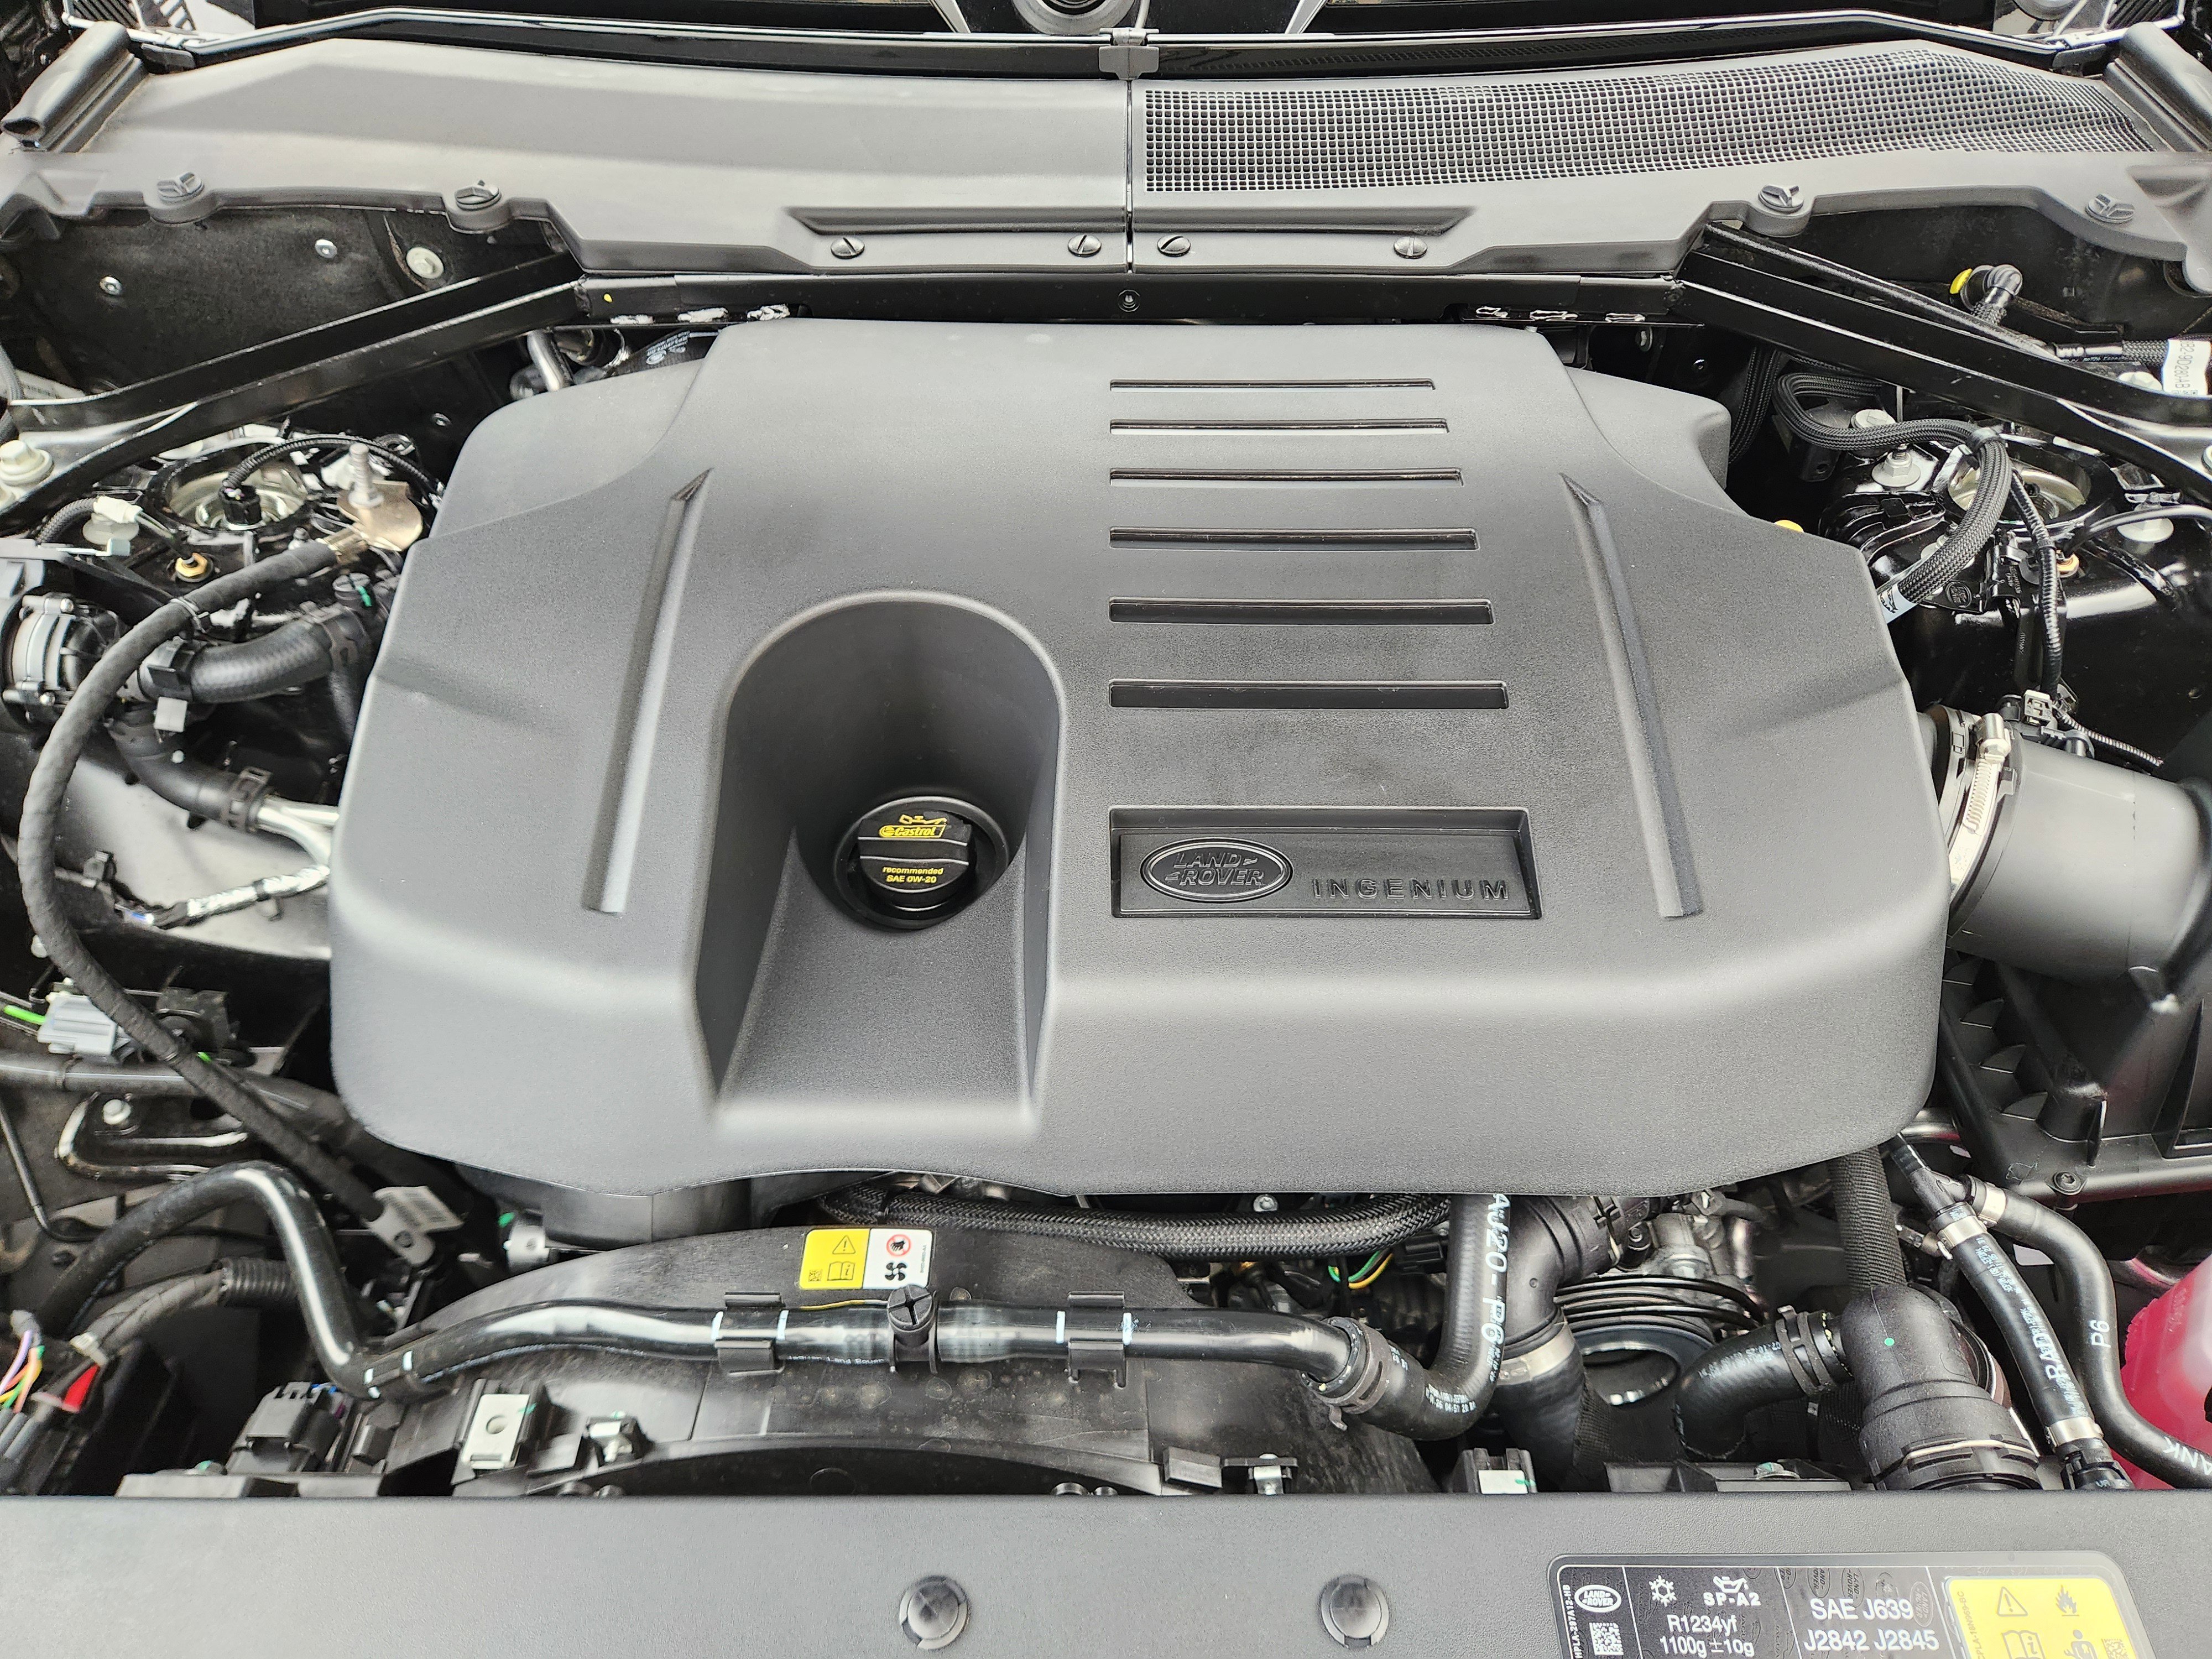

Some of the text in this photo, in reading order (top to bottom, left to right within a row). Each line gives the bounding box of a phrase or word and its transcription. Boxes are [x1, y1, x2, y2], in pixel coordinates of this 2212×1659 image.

[894, 826, 936, 836] Castrol
[1174, 853, 1241, 868] LAND
[886, 874, 905, 883] SAE
[1180, 868, 1264, 885] ROVER
[1312, 878, 1509, 900] INGENIUM
[1481, 1297, 1505, 1345] P6
[2090, 1319, 2111, 1348] P6
[826, 1356, 851, 1364] Land
[1587, 1598, 1614, 1606] ROVER
[1703, 1592, 1761, 1606] SP-A2
[1810, 1598, 1914, 1620] SAE J639
[1667, 1614, 1738, 1637] R1234yf
[1660, 1635, 1708, 1658] 1100g
[1804, 1628, 1939, 1651] J2842 J2845
